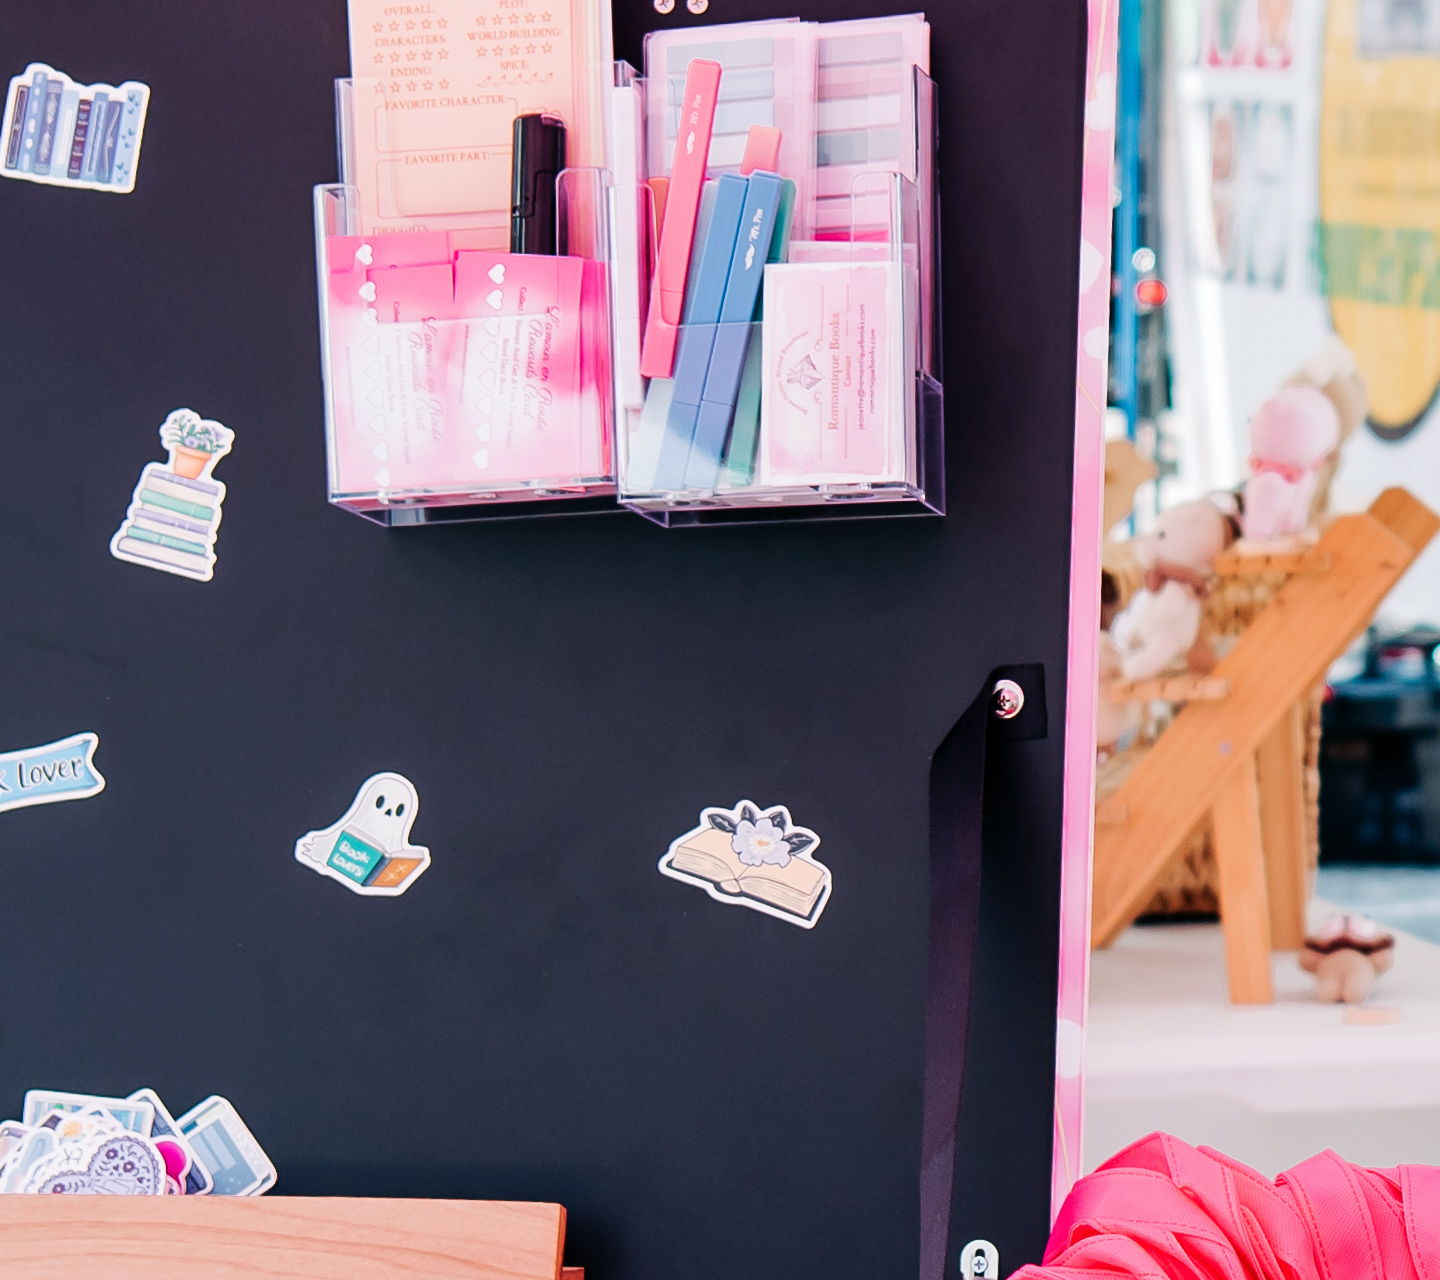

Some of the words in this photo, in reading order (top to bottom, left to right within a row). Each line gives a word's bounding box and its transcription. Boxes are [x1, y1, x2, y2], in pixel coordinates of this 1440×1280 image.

[467, 30, 508, 42] WORLD
[385, 98, 438, 111] FAVORITE
[405, 154, 457, 165] FAVORITE
[828, 312, 841, 350] Books
[828, 354, 843, 431] Romantique
